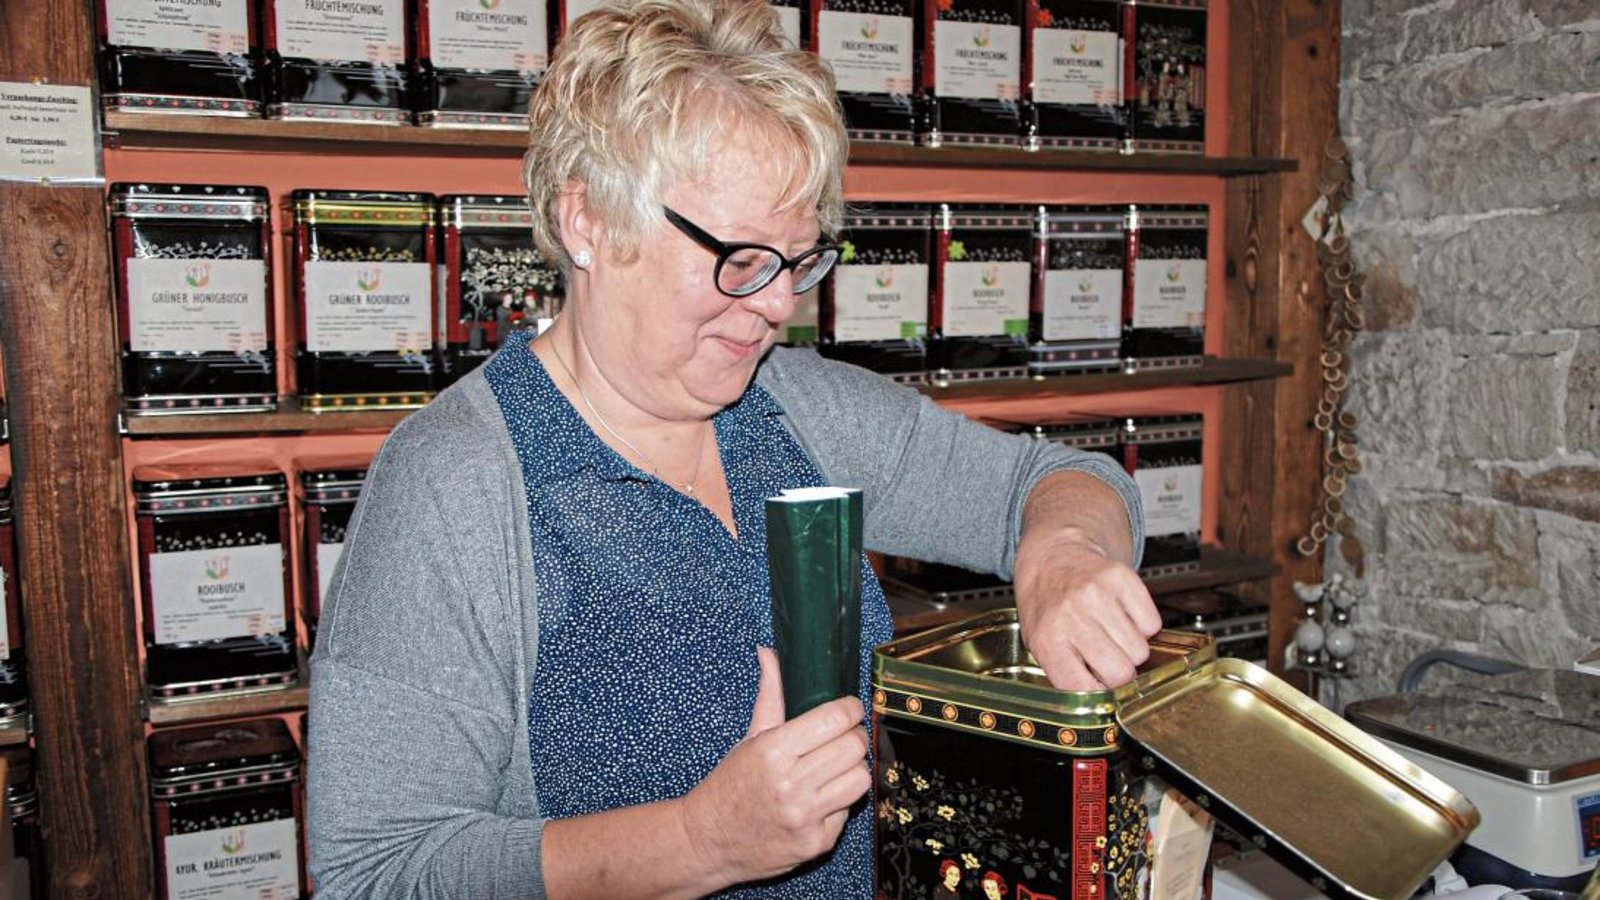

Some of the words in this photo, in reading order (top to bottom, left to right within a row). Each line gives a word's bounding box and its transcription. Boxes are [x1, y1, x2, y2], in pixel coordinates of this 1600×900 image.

[152, 290, 188, 304] GRÜNER
[192, 293, 248, 304] HONIGBUSCH
[329, 292, 362, 305] GRÜNER
[198, 582, 245, 595] ROOIBUSCH
